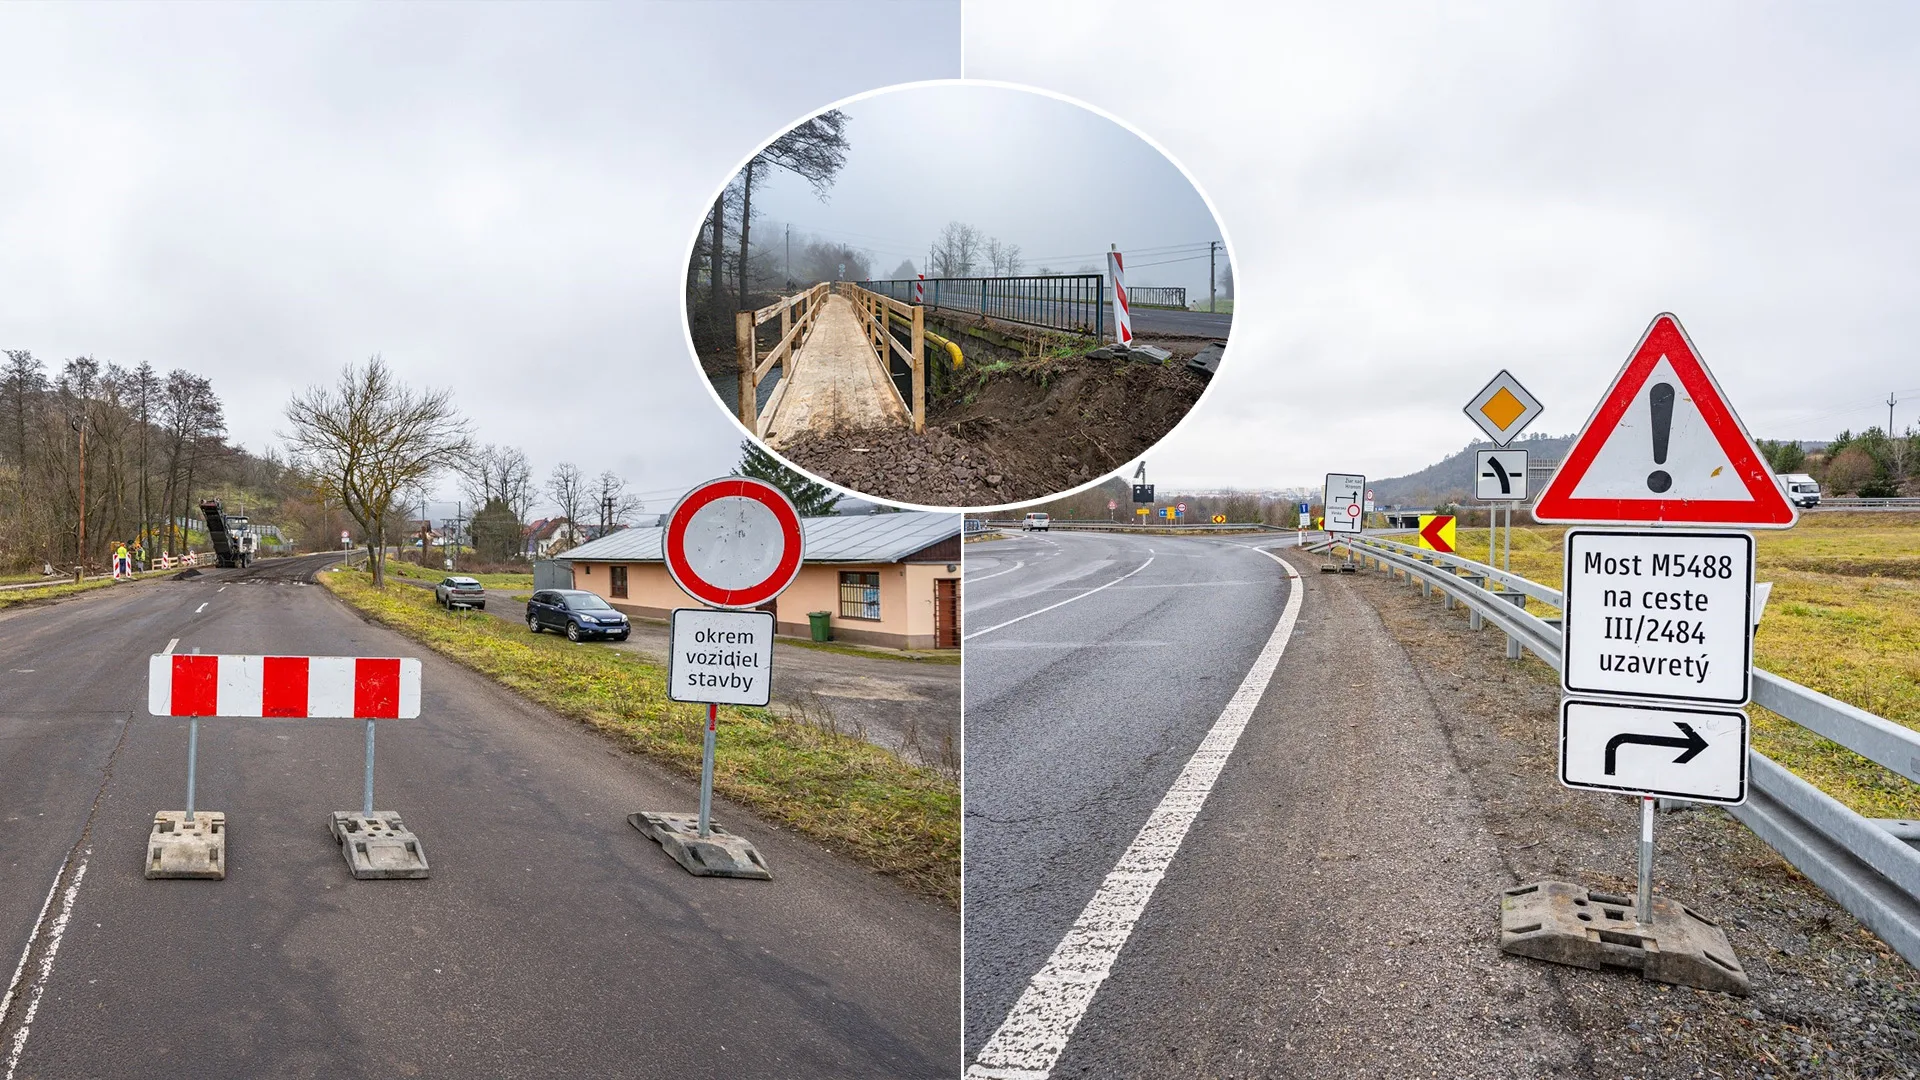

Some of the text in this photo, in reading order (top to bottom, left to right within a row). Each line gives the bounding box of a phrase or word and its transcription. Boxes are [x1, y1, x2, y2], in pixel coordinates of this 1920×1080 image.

[1585, 552, 1733, 579] Most M5488
[1604, 589, 1709, 612] na ceste
[695, 628, 754, 644] okrem
[1604, 615, 1706, 645] III/2484
[686, 650, 759, 668] vozidiel
[1600, 653, 1710, 684] uzavretý
[688, 672, 753, 693] stavby
